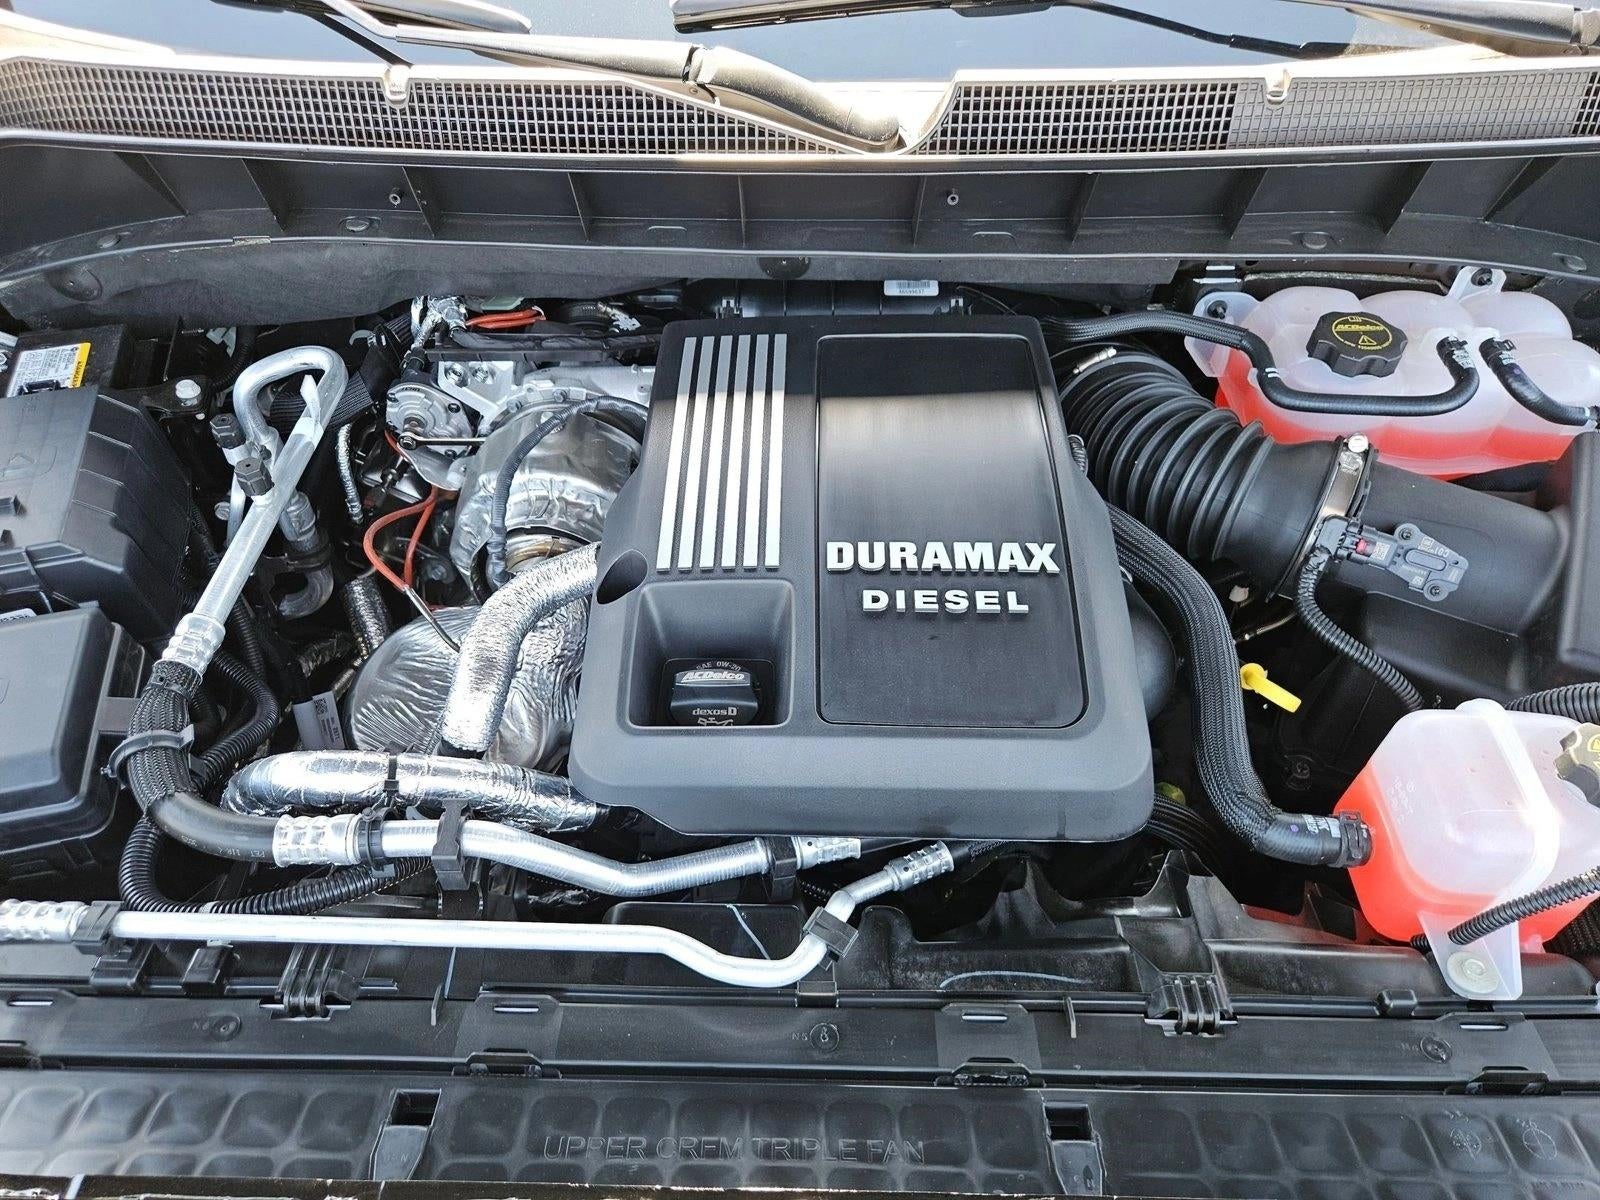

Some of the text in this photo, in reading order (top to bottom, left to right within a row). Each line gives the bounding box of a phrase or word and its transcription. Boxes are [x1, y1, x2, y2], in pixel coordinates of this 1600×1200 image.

[826, 541, 1060, 574] DURAMAX
[862, 589, 1029, 614] DIESEL
[681, 671, 744, 682] ACDelco
[692, 706, 738, 716] dexosD
[543, 1136, 648, 1161] UPPER
[751, 1137, 859, 1163] TRIPLE
[866, 1139, 925, 1166] FAN
